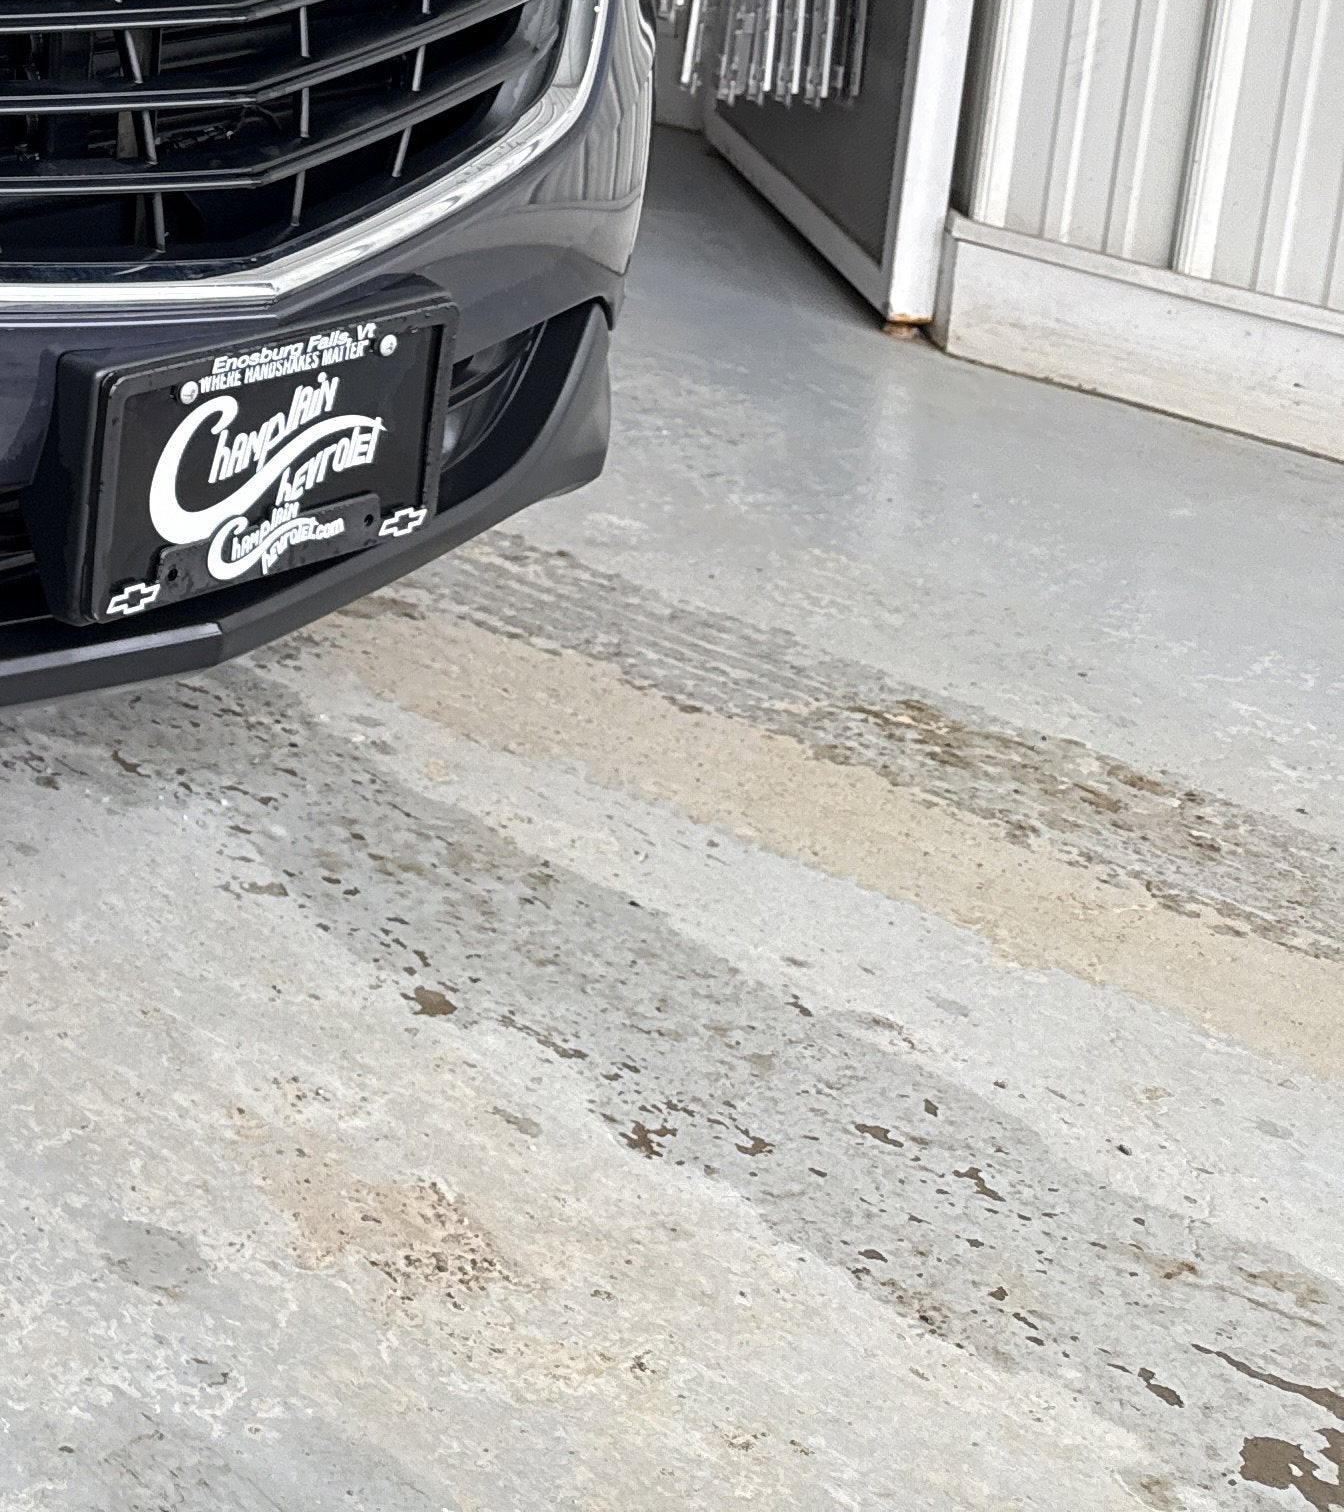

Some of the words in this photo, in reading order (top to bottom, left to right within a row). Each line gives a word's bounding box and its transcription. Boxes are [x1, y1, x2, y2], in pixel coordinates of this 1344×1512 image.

[198, 369, 242, 393] WHERE
[244, 350, 320, 384] HANDSHAKES
[321, 339, 370, 367] MATTER
[212, 341, 305, 374] Enosburg
[357, 323, 377, 340] Vt
